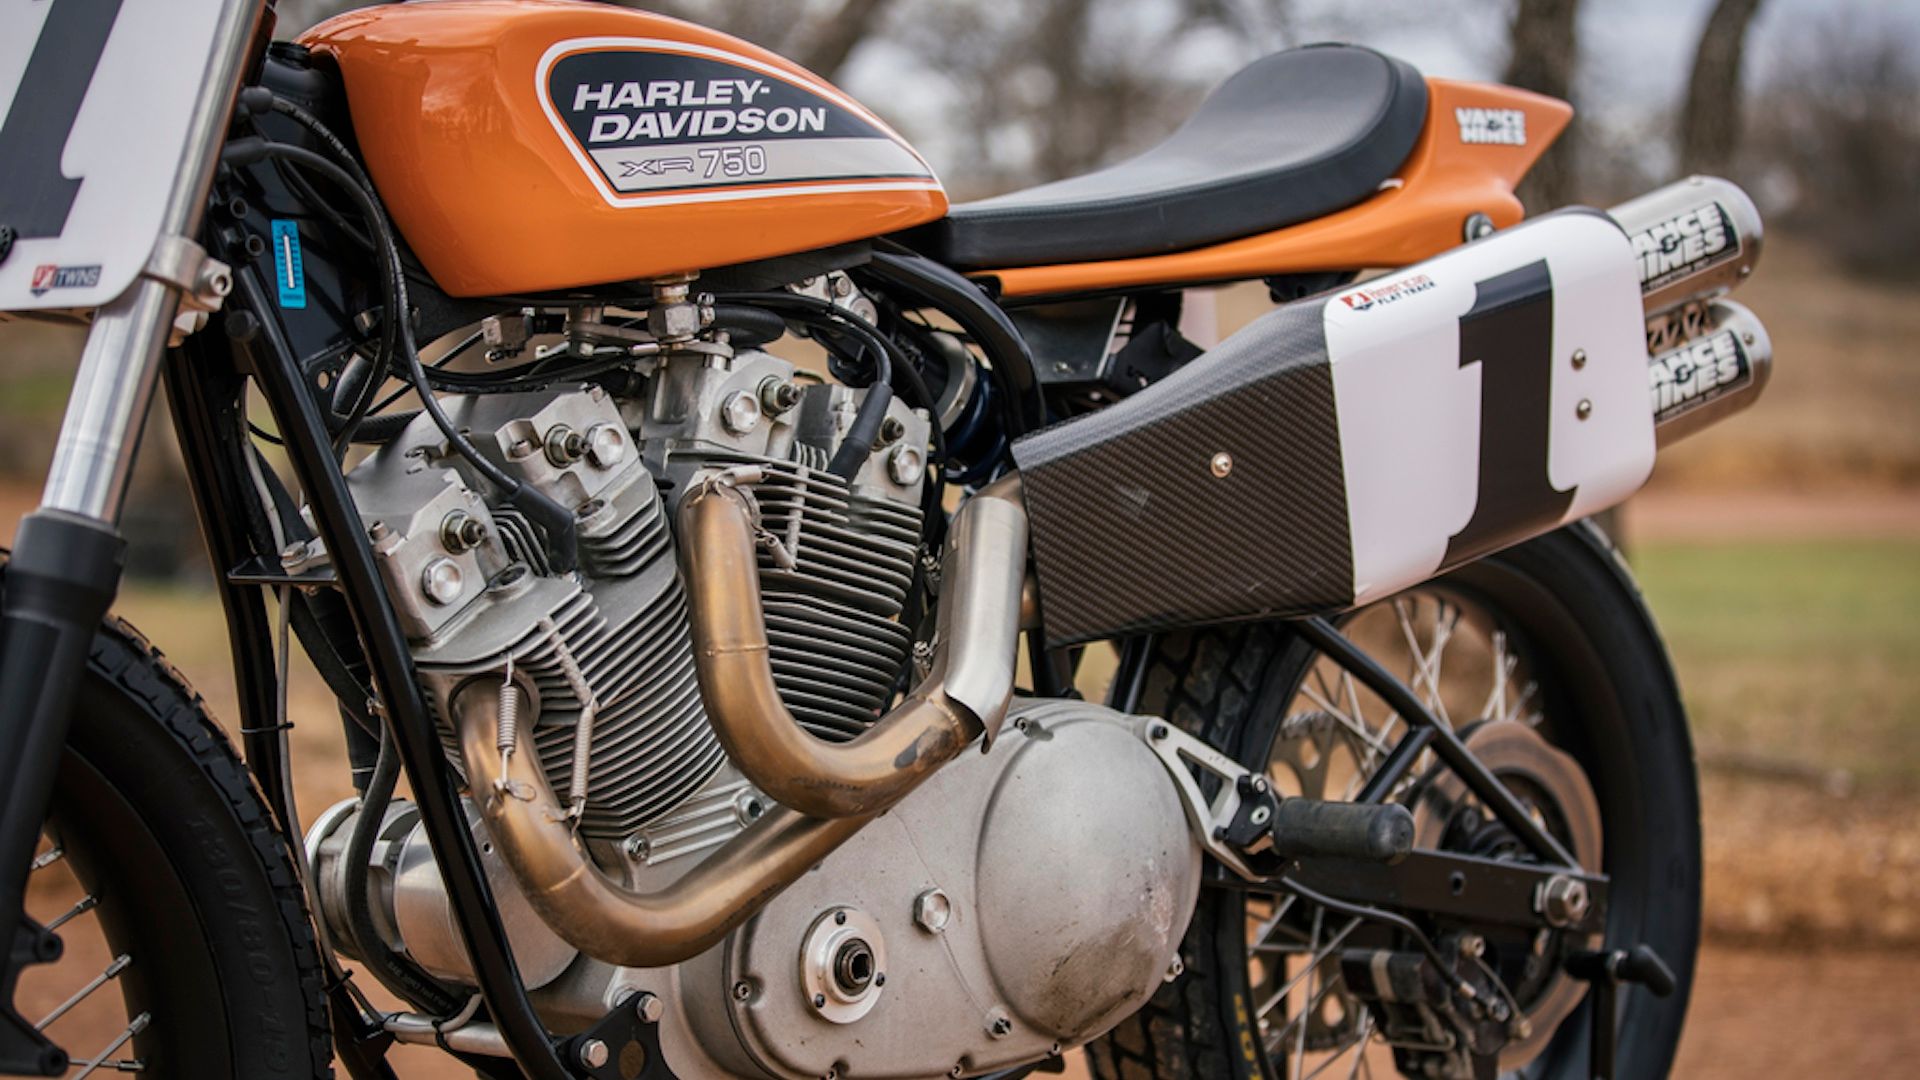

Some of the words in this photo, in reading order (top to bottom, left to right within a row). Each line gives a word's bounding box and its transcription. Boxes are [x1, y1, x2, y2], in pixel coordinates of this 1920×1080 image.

[573, 80, 770, 111] HARLEY-
[588, 108, 827, 143] DAVIDSON
[1455, 107, 1525, 127] VANCE
[1631, 201, 1722, 254] ANCE
[1377, 292, 1402, 305] FLAT
[1403, 281, 1436, 296] TRACK
[1649, 329, 1736, 389] ANCE
[1432, 259, 1578, 575] 1
